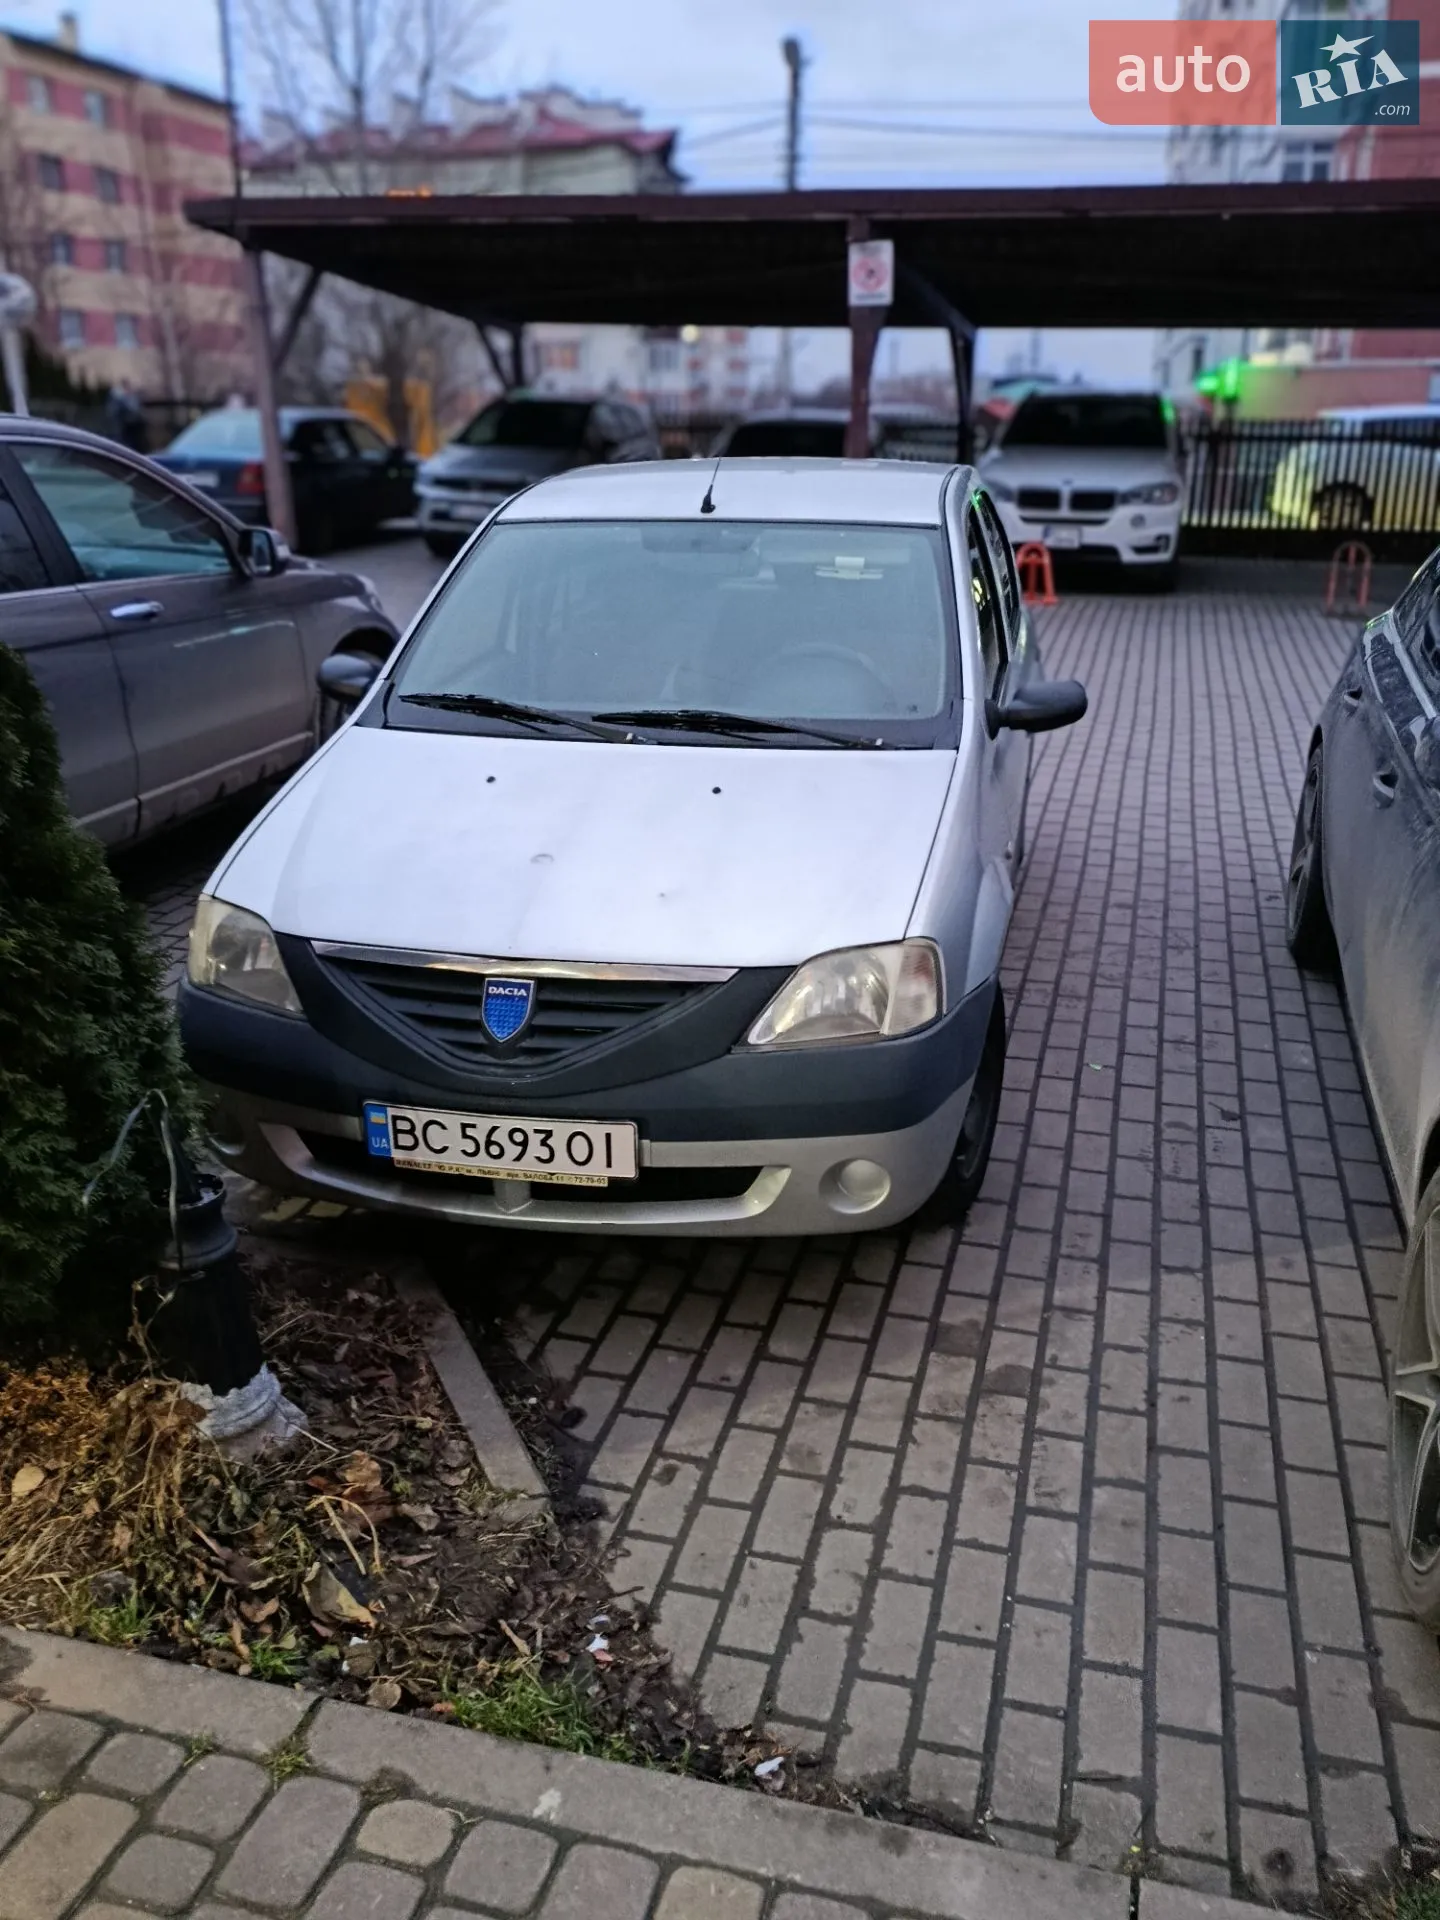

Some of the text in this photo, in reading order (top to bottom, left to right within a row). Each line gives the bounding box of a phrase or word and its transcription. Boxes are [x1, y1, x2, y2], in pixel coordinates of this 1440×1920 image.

[488, 985, 528, 997] DACIA
[371, 1136, 390, 1148] UA
[391, 1114, 449, 1154] BC
[459, 1122, 555, 1164] 5693
